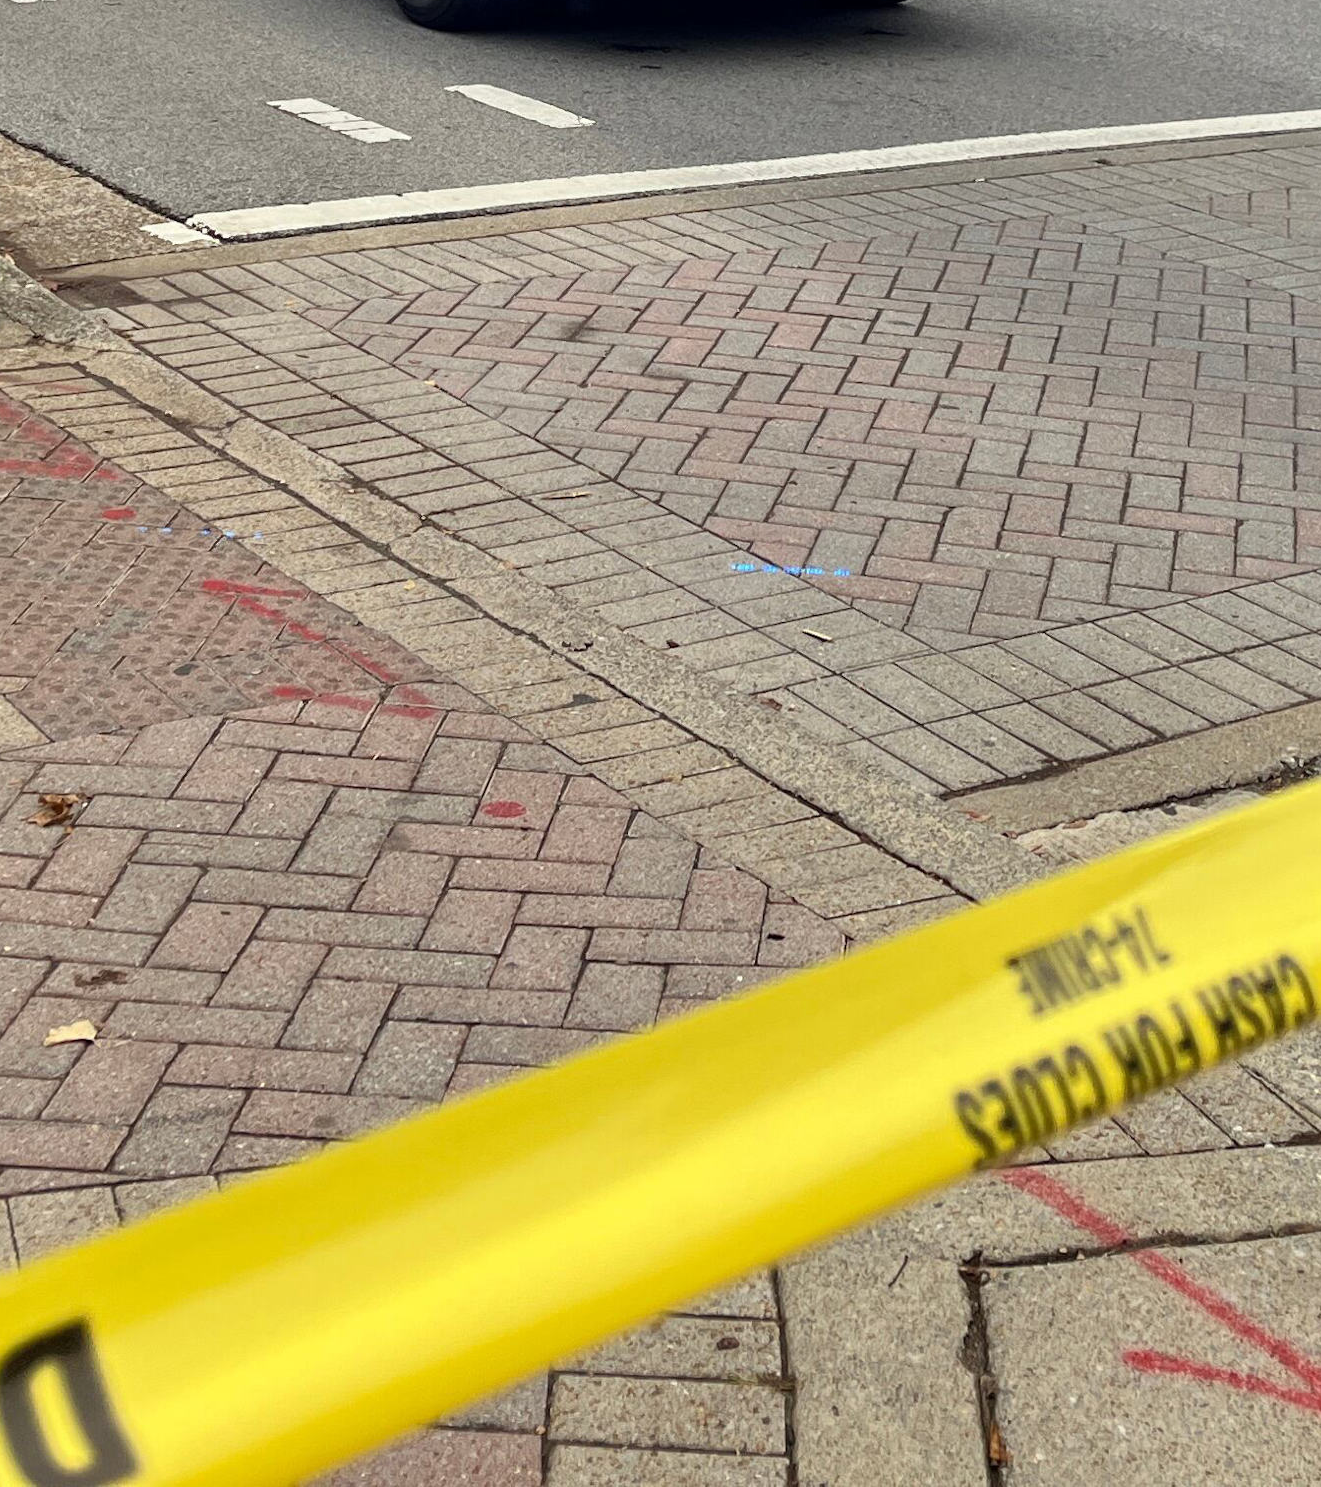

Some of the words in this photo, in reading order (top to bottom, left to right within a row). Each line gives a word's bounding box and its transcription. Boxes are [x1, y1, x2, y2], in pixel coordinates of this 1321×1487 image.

[1102, 998, 1201, 1099] FOR
[1196, 954, 1318, 1057] CASH
[954, 1043, 1108, 1163] CLUES
